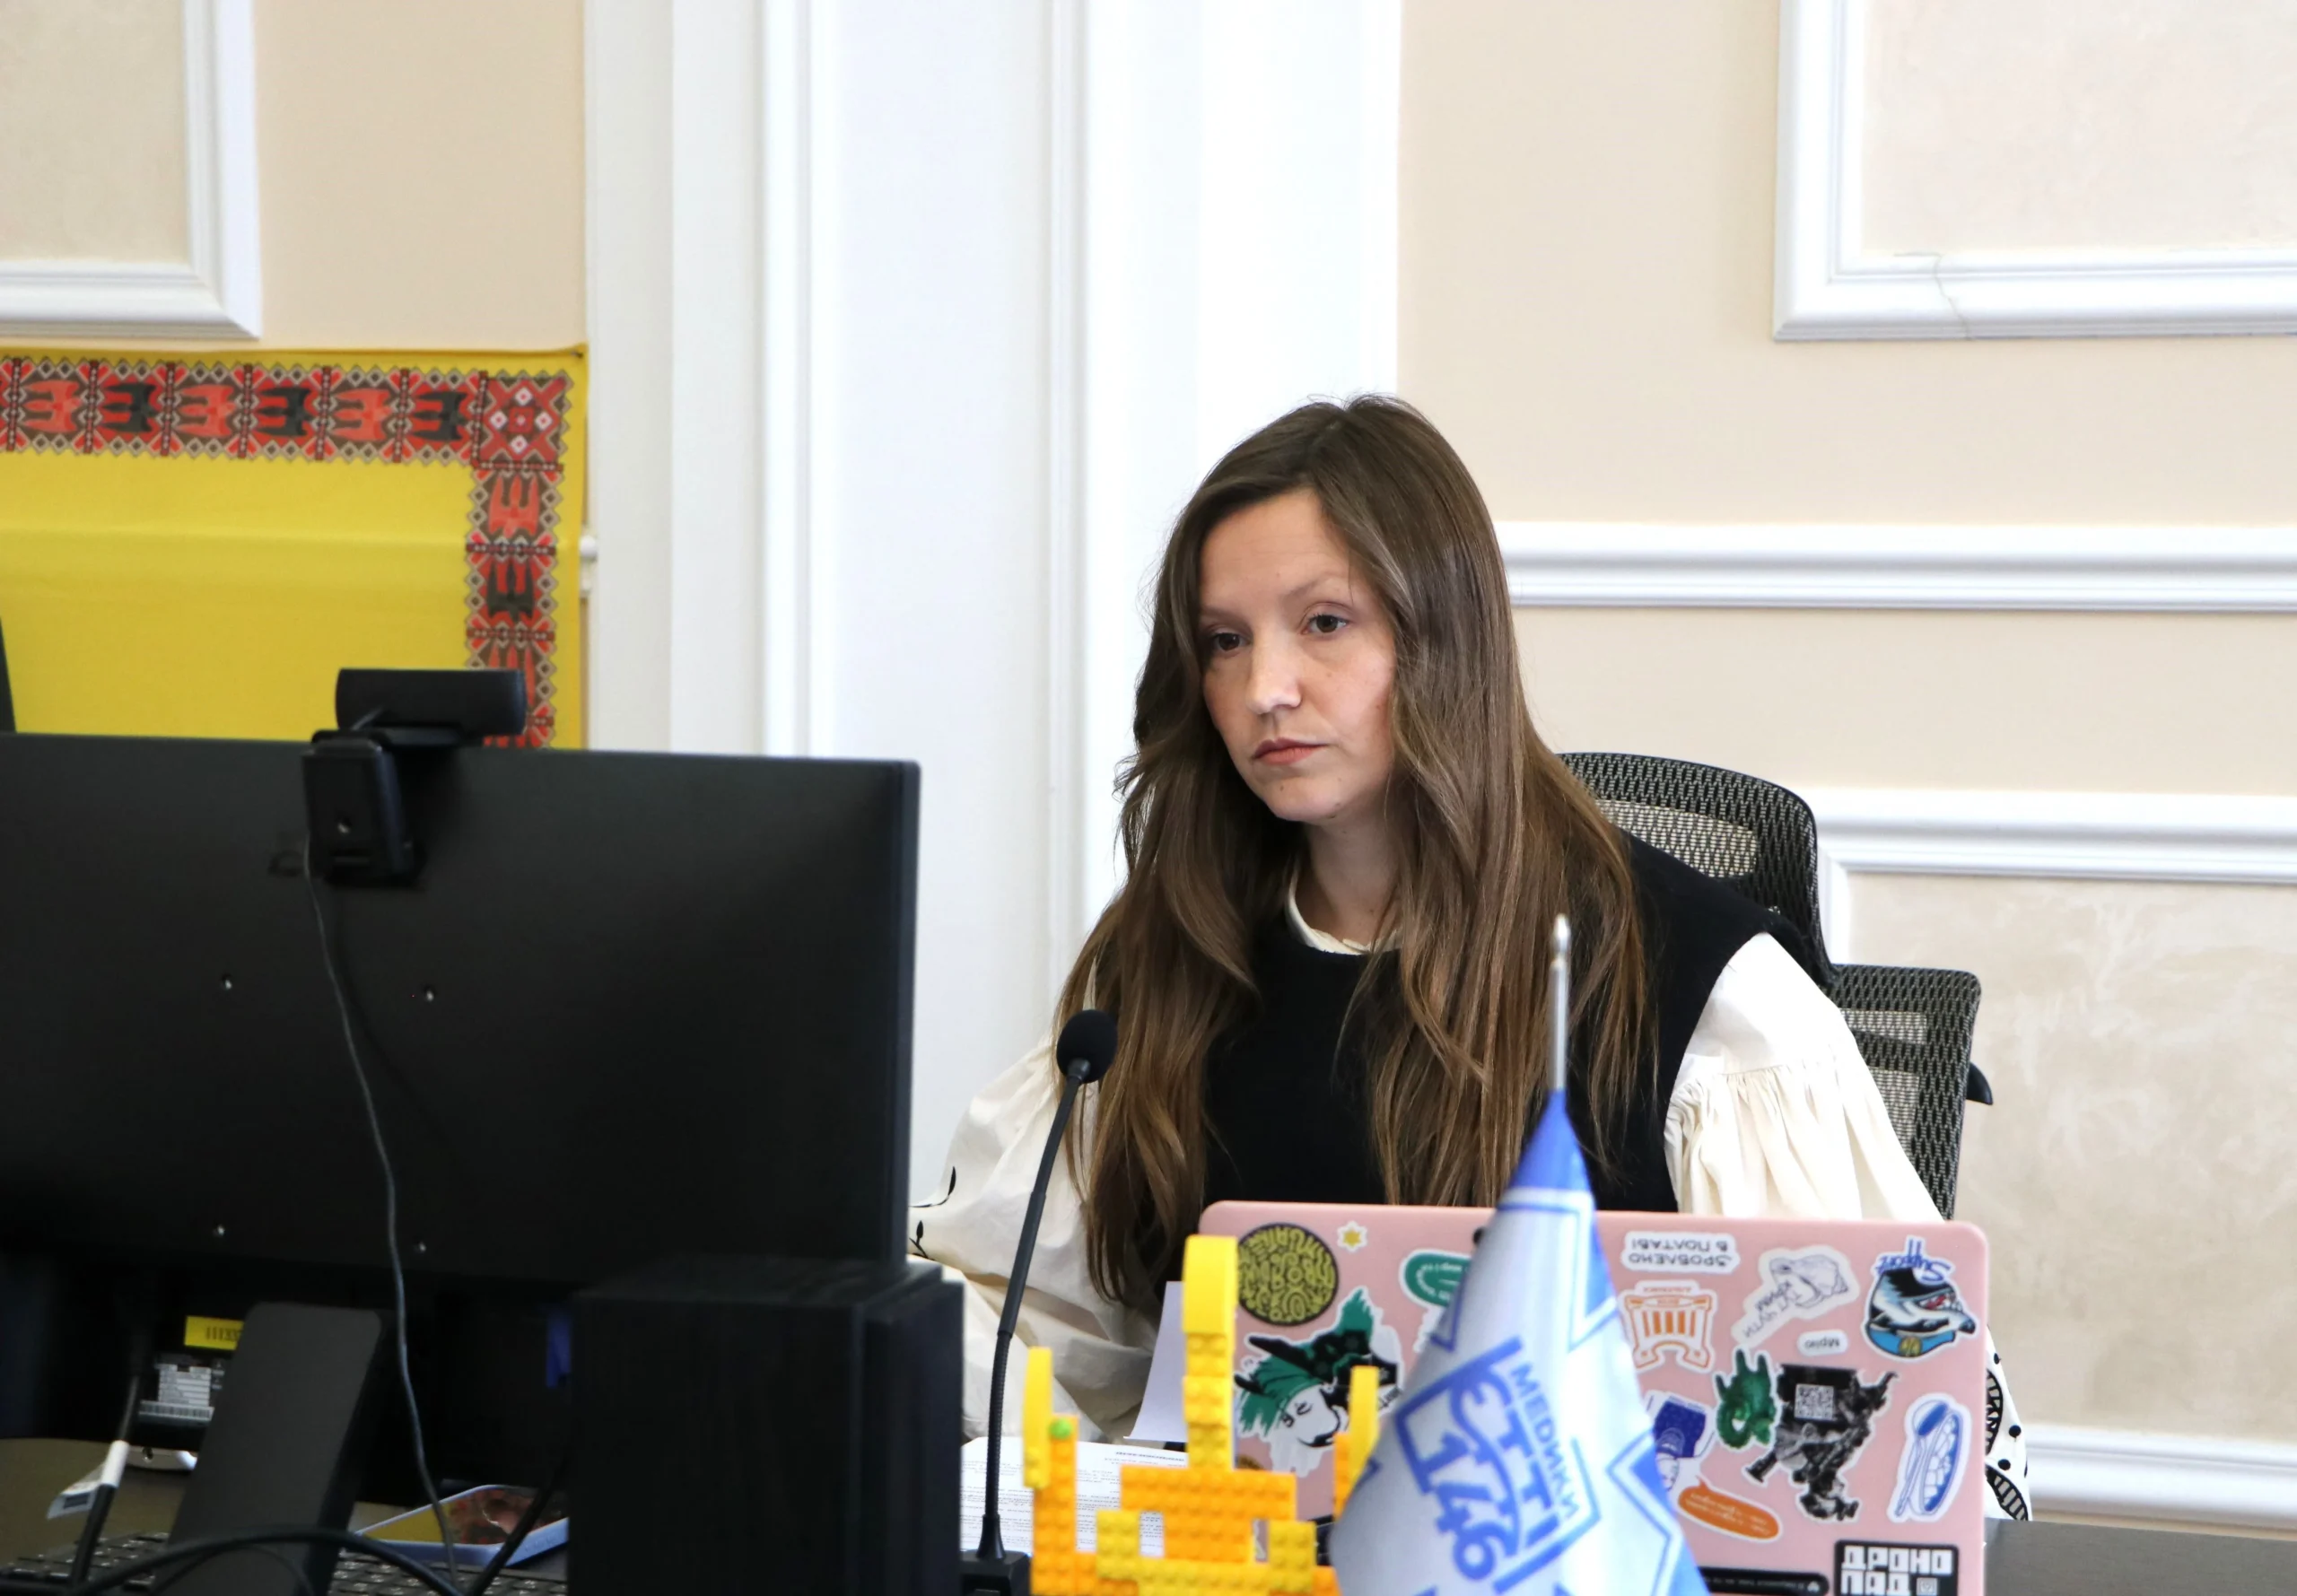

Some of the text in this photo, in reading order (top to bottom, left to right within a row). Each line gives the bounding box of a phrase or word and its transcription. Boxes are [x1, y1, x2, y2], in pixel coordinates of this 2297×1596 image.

[1631, 1238, 1727, 1253] В ПОЛТАВІ
[1629, 1252, 1732, 1267] ЗРОБЛЕНО
[1417, 1431, 1518, 1580] 146
[1841, 1545, 1952, 1575] ДРОНО
[1840, 1569, 1911, 1595] ПАД
